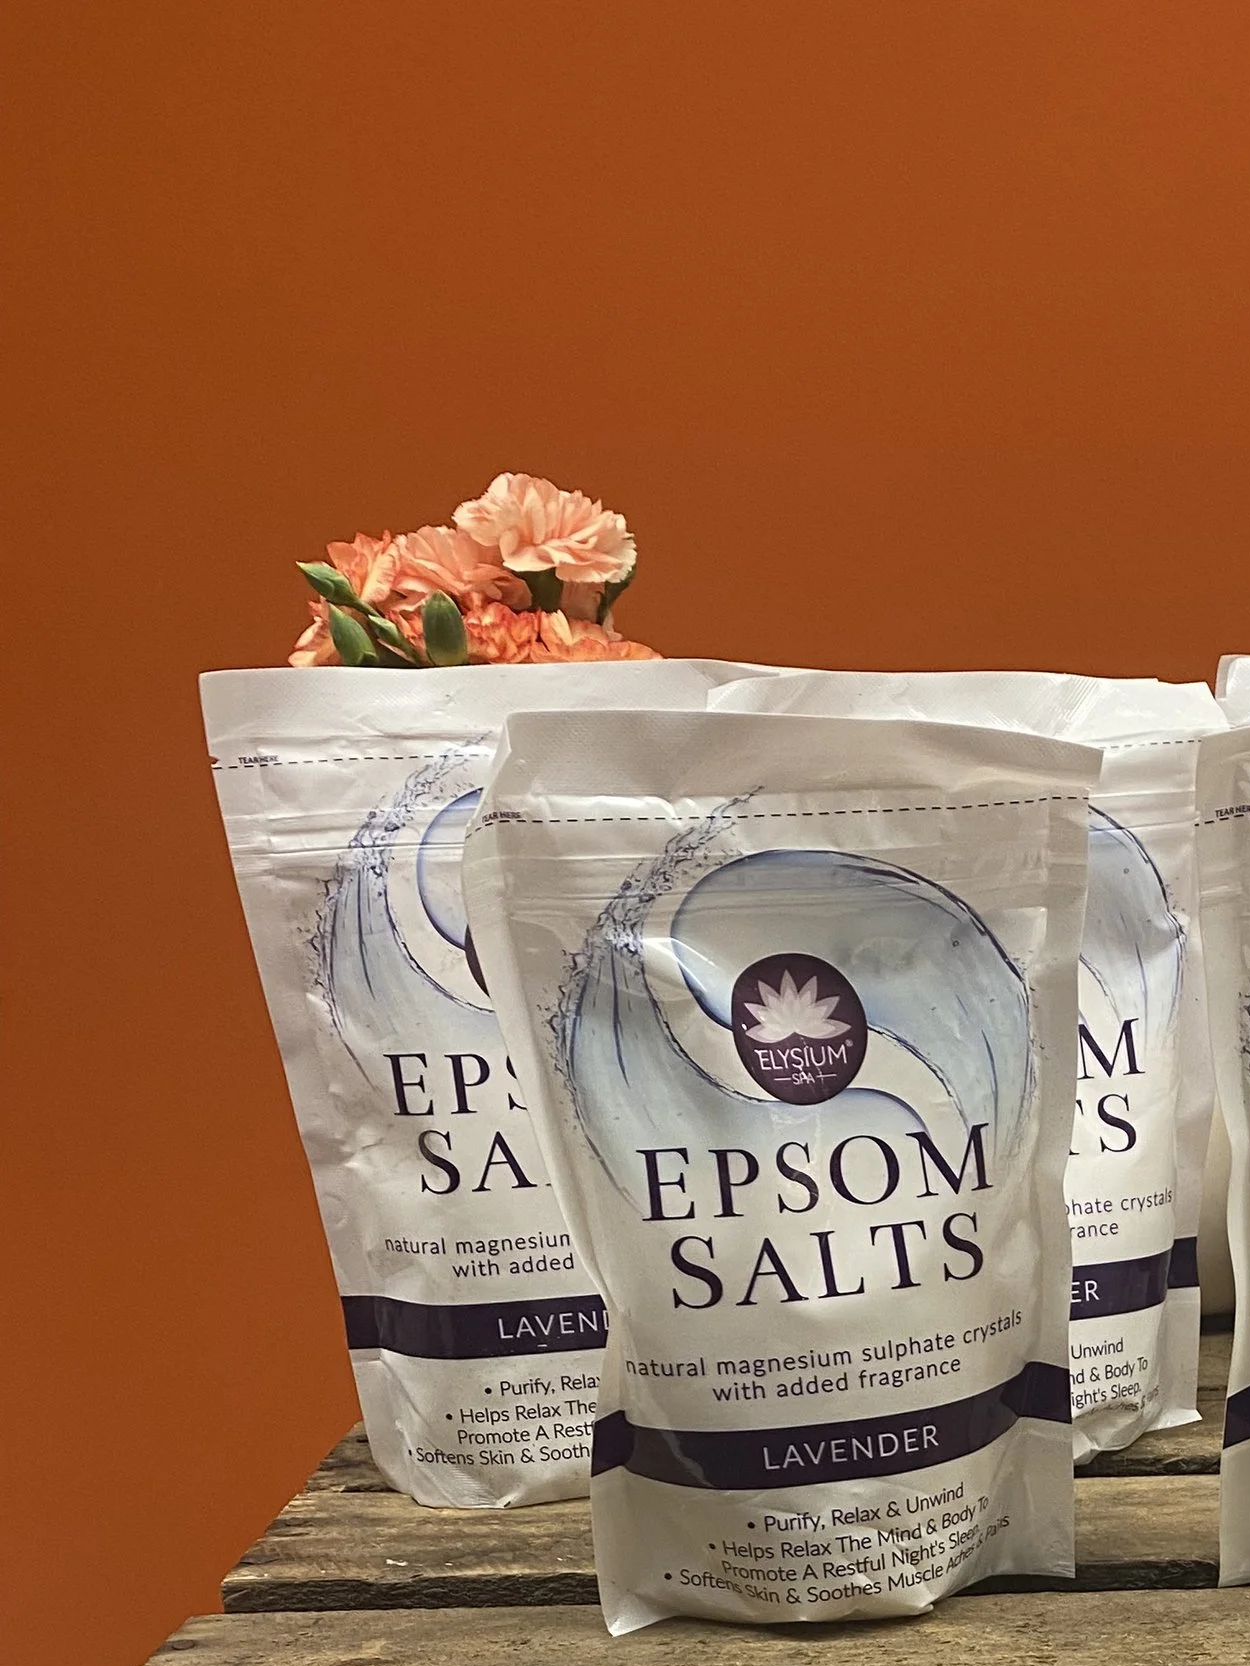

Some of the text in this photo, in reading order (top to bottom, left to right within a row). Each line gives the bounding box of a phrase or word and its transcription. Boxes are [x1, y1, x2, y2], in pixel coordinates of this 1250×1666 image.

[1215, 807, 1234, 818] TEAR
[756, 1043, 849, 1072] ELYSIUM
[792, 1071, 815, 1084] SPA
[635, 1123, 993, 1221] EPSOM
[1120, 1187, 1172, 1213] crystals
[385, 1237, 446, 1255] natural
[452, 1253, 575, 1278] with added
[670, 1212, 984, 1310] SALTS
[626, 1310, 1023, 1377] natural magnesium sulphate crystals
[1071, 1337, 1124, 1359] Unwind
[712, 1356, 961, 1402] with added fragrance
[1090, 1361, 1135, 1382] & Body
[460, 1400, 597, 1425] Helps Relax The
[417, 1447, 535, 1466] Softens Skin &
[763, 1425, 939, 1471] LAVENDER
[763, 1481, 965, 1535] Purify, Relax & Unwind
[723, 1539, 775, 1561] Helps
[781, 1539, 831, 1558] Relax
[836, 1533, 873, 1553] The
[877, 1525, 923, 1547] Mind
[926, 1520, 938, 1536] &
[941, 1508, 975, 1533] Body
[721, 1541, 946, 1582] Promote A Restful Night's
[680, 1564, 944, 1604] Softens Skin & Soothes Muscle
